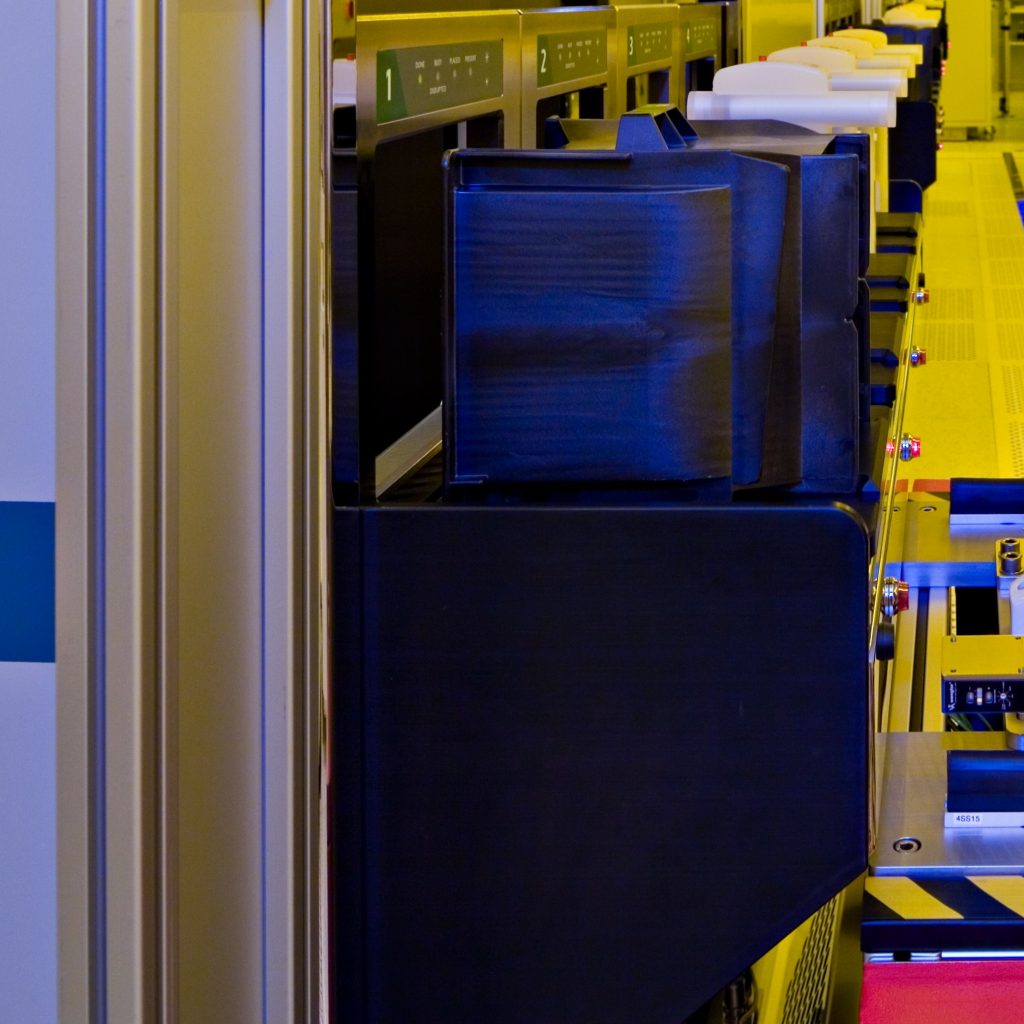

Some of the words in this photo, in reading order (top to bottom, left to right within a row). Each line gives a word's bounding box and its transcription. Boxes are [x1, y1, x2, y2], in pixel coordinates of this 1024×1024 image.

[629, 36, 635, 56] 3
[540, 48, 547, 74] 2
[385, 67, 392, 102] 1
